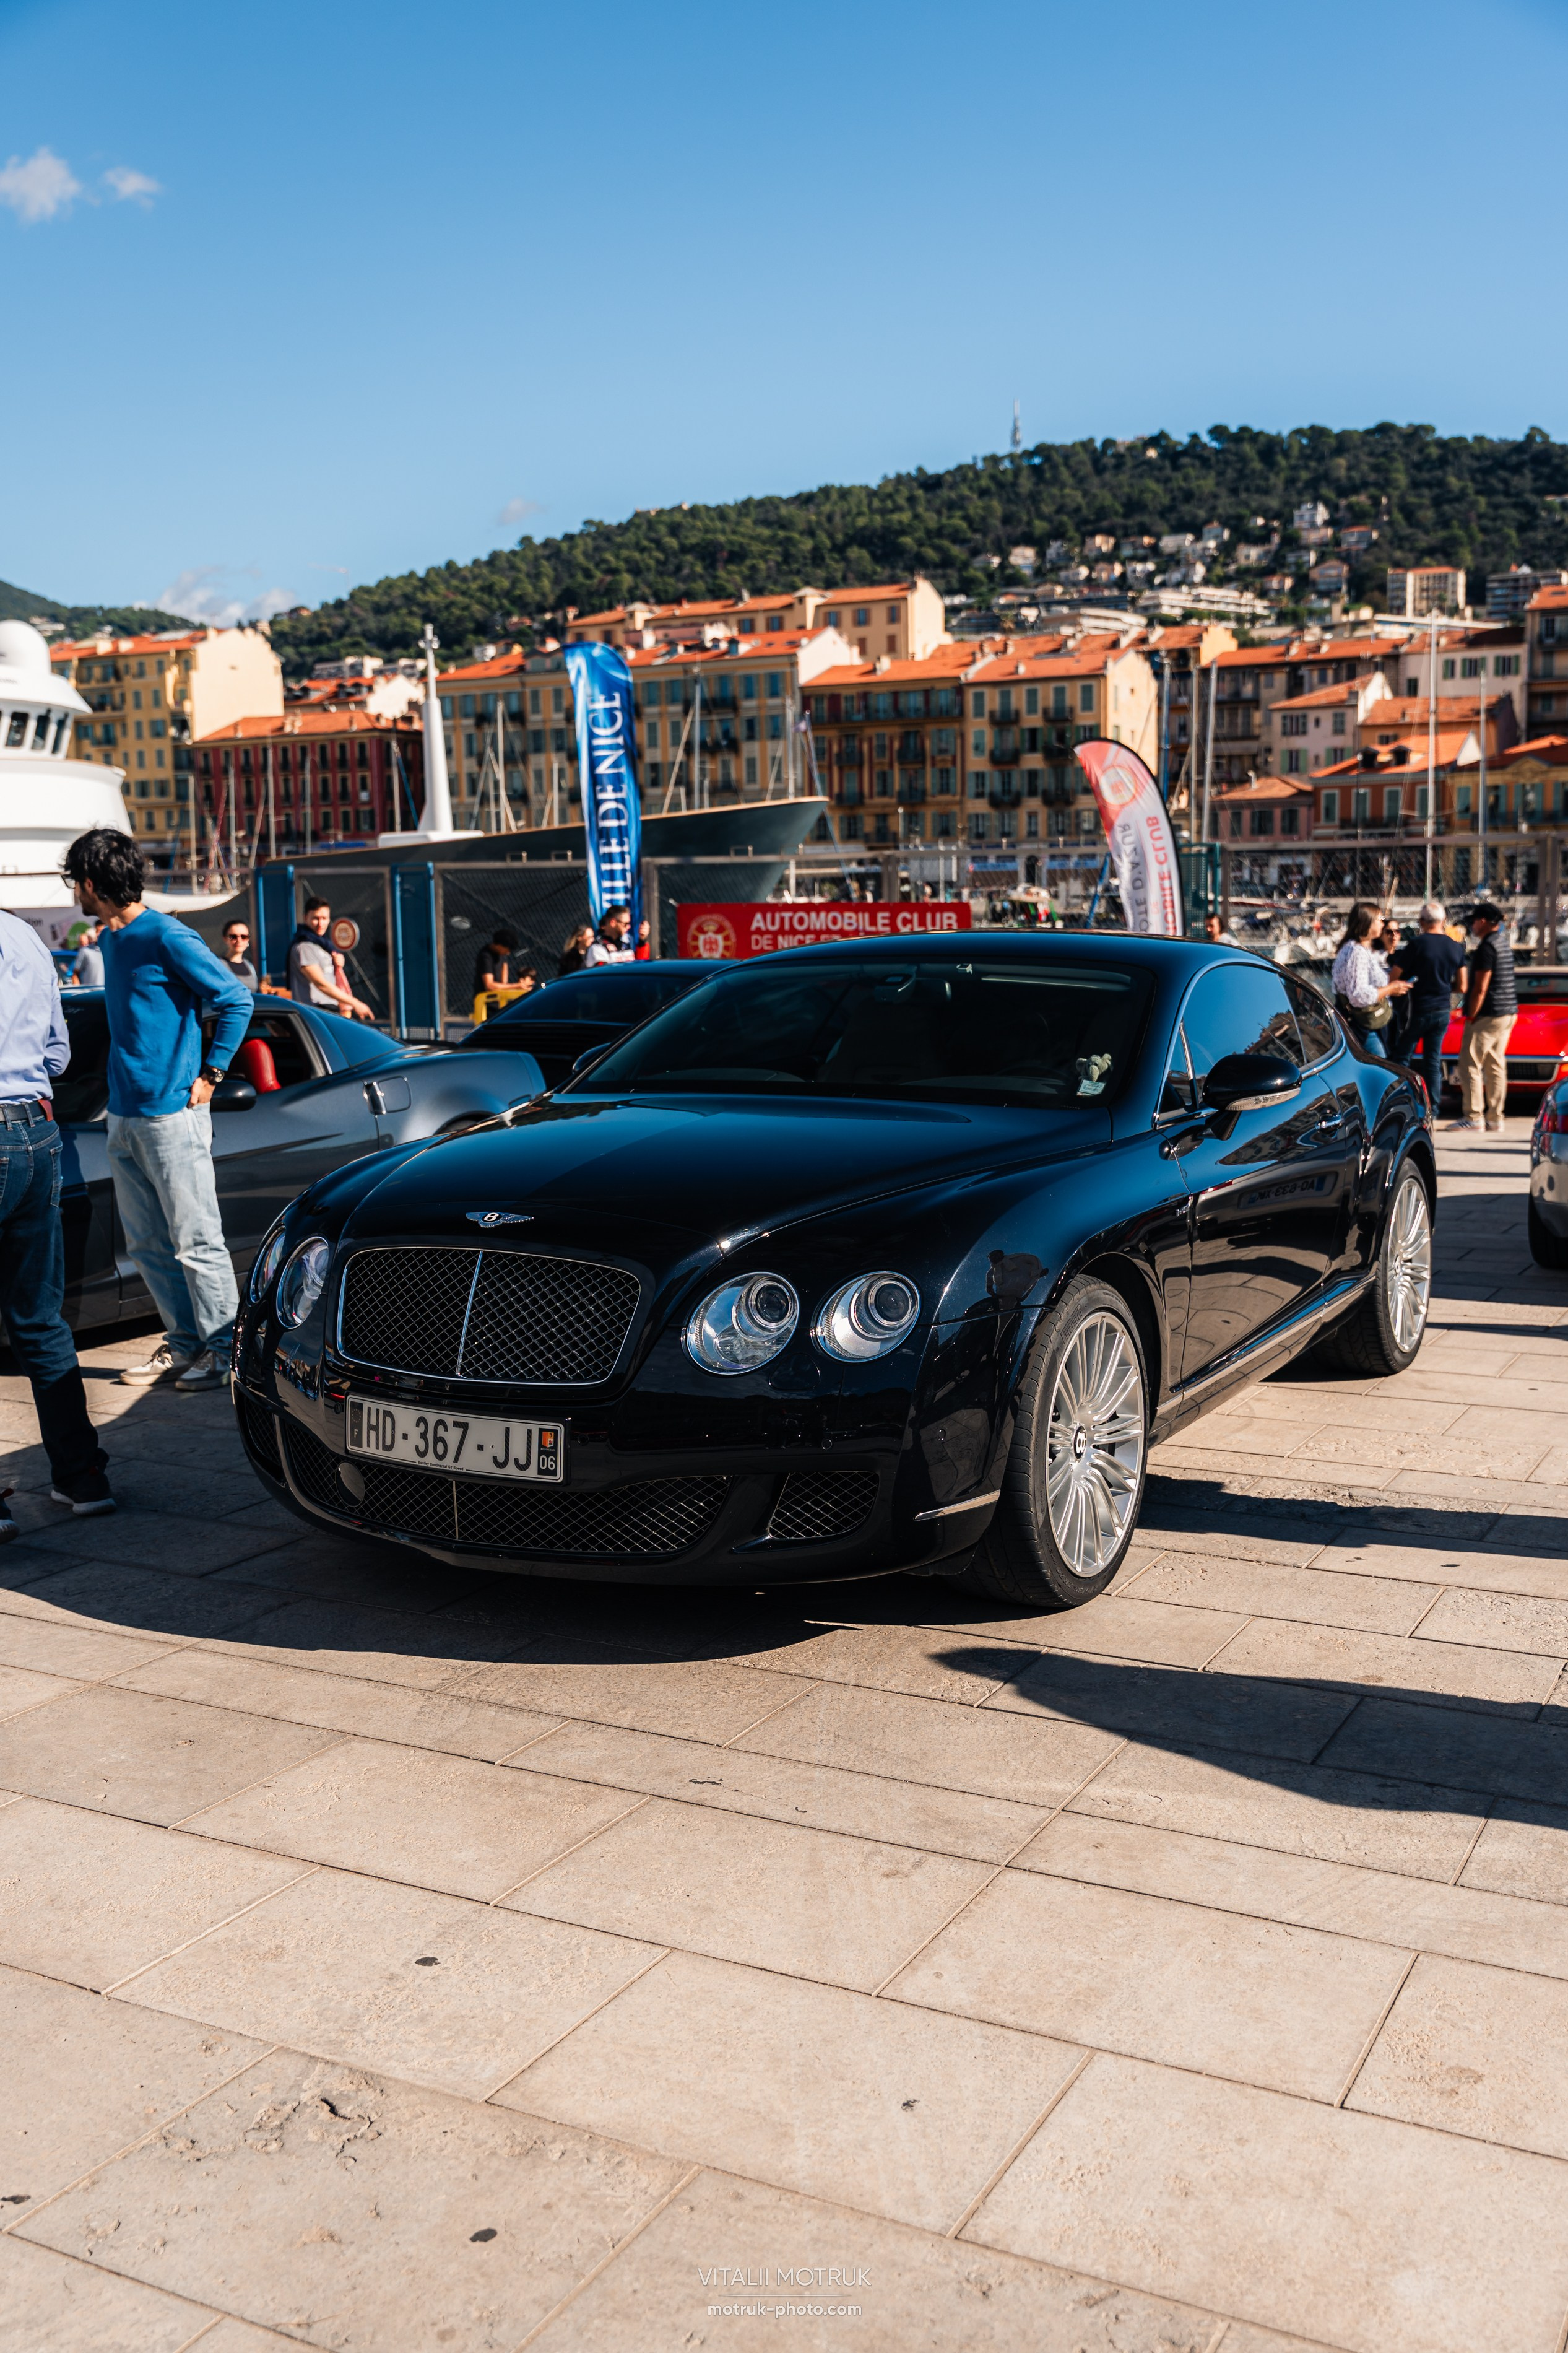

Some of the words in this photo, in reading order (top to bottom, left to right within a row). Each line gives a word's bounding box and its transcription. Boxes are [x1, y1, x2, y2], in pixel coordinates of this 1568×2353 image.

[588, 691, 626, 774] NICE
[596, 784, 628, 827] DE
[750, 911, 890, 931] AUTOMOBILE
[896, 911, 958, 932] CLUB
[751, 934, 774, 950] DE
[354, 1429, 358, 1438] F
[539, 1455, 555, 1471] 06
